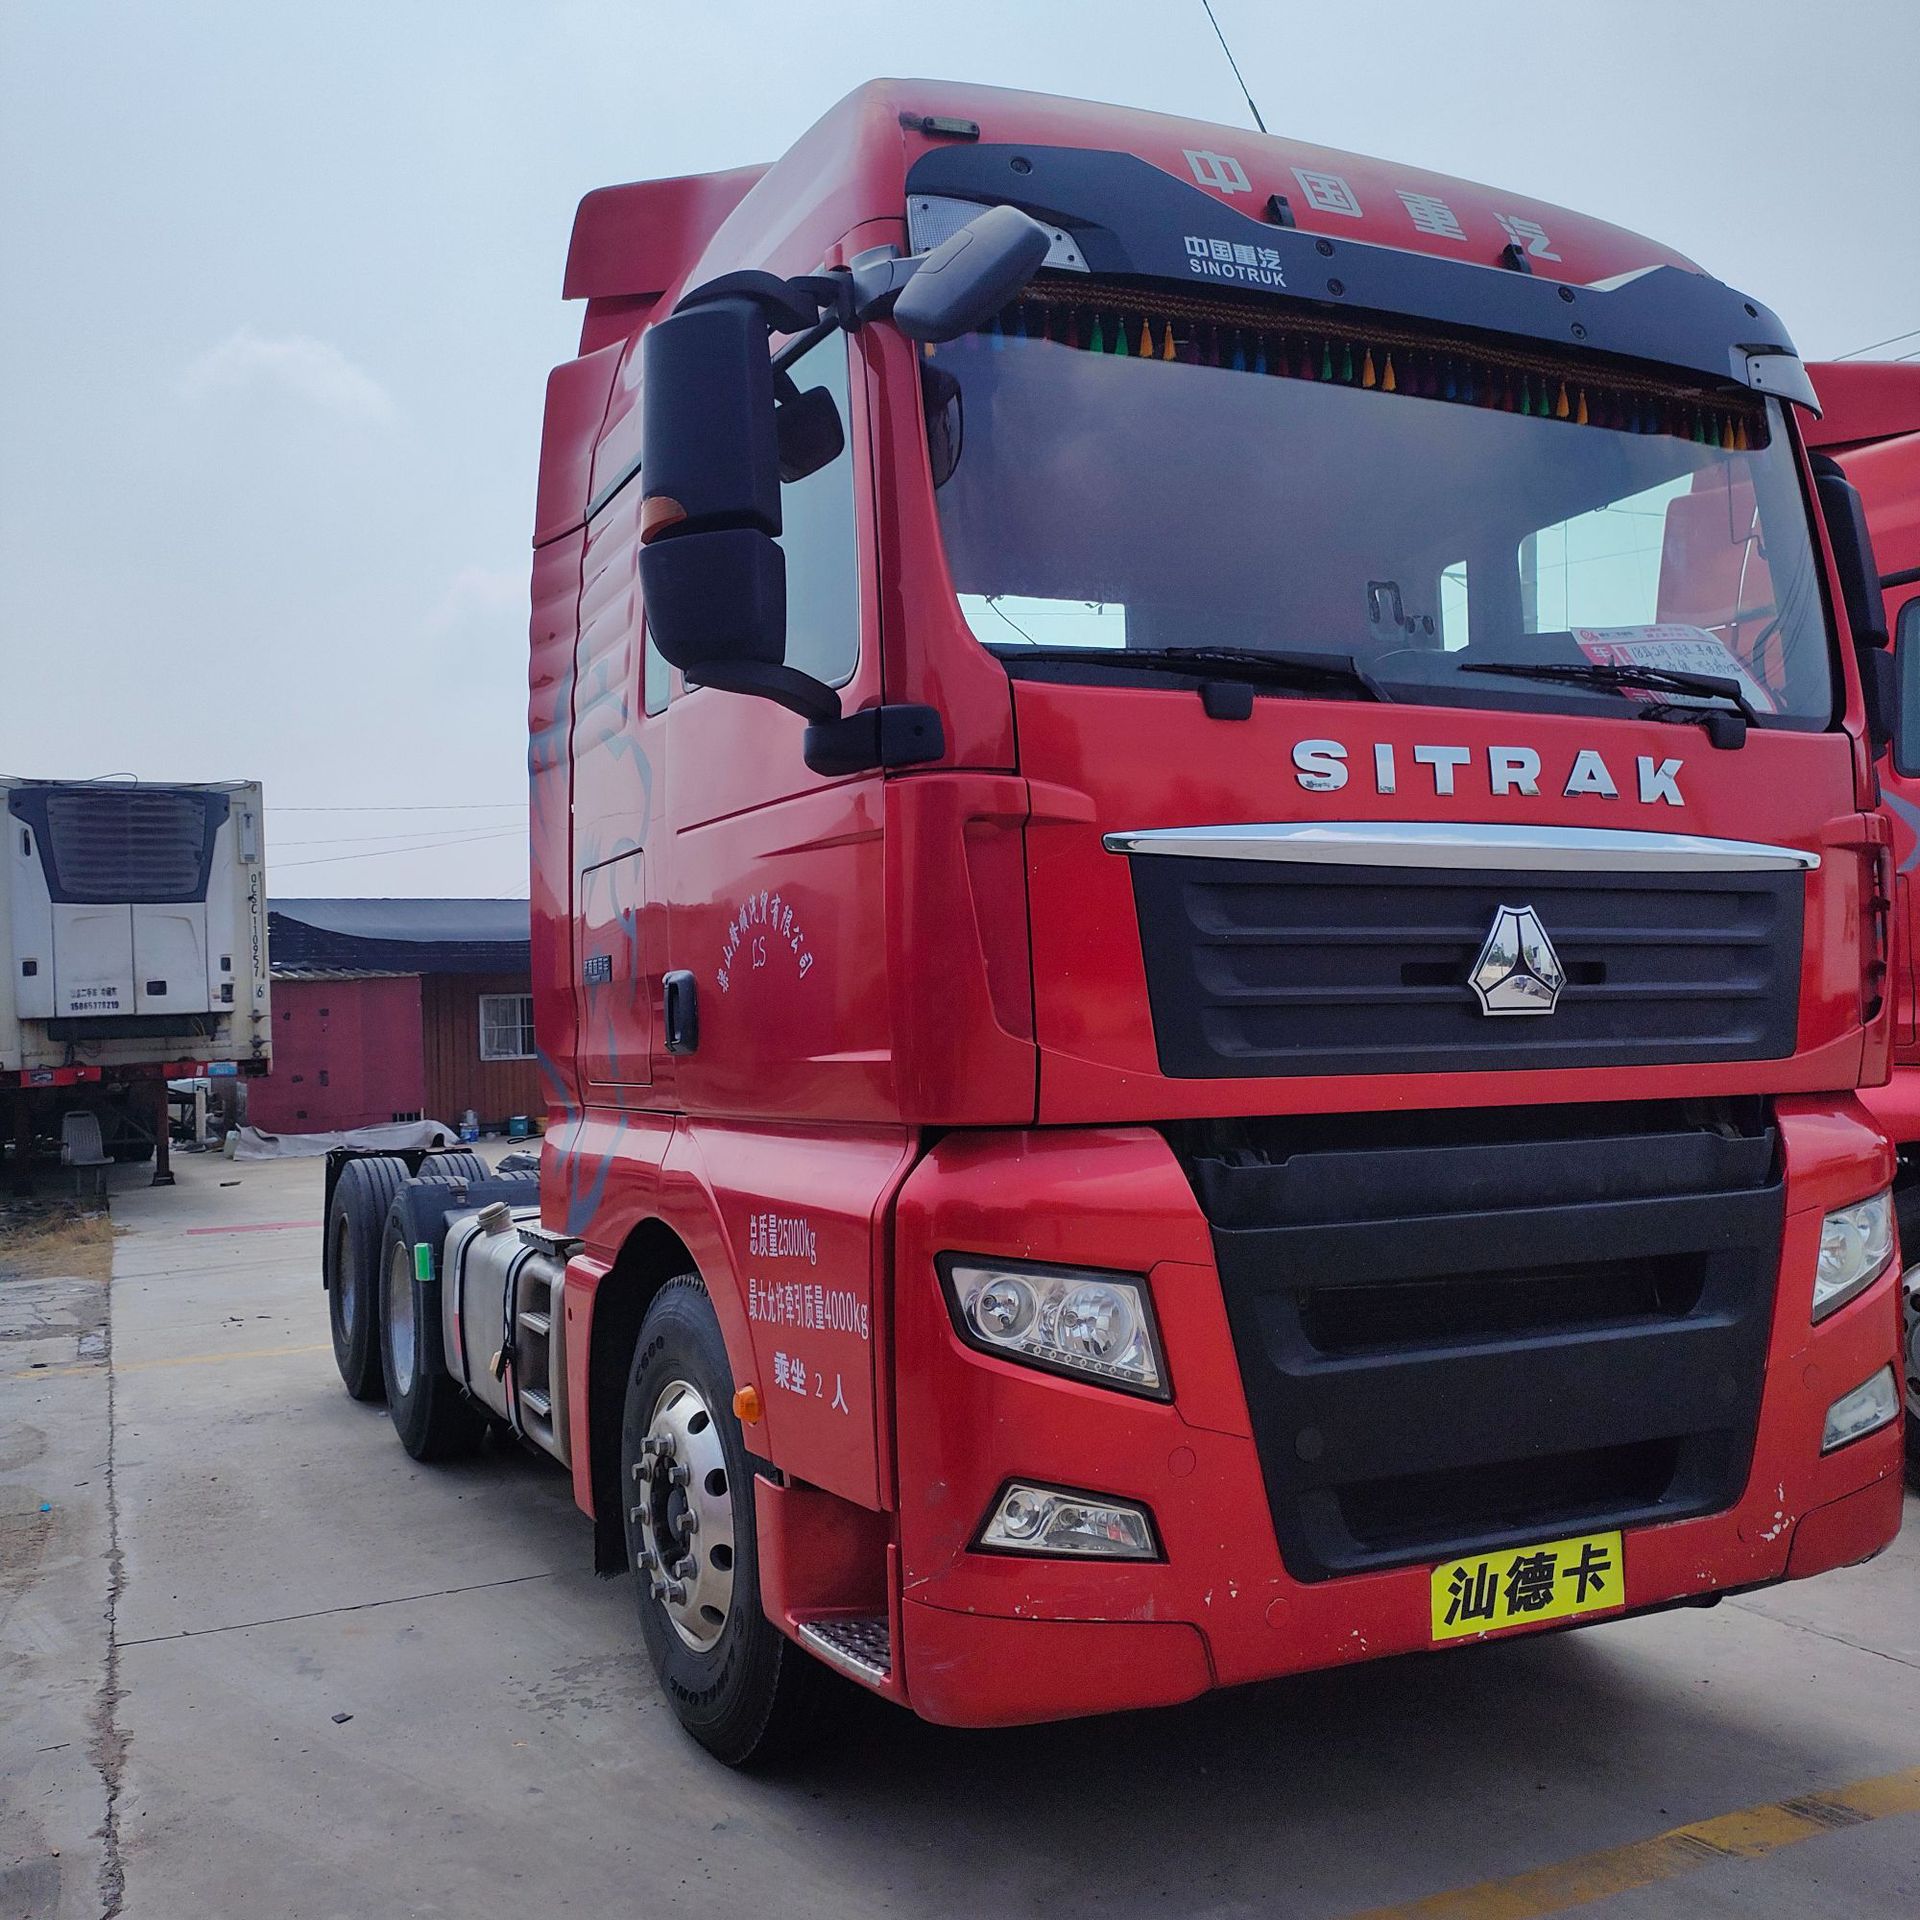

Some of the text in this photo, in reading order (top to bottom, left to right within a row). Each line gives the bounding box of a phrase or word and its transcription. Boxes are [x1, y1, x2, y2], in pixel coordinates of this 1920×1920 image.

[1182, 148, 1562, 263] 中国重汽
[1183, 235, 1282, 271] 中国重汽
[1189, 257, 1287, 288] SINOTRUK
[1292, 739, 1685, 807] SITRAK
[749, 1213, 817, 1266] 总质量25000kg
[748, 1278, 870, 1340] 最大允许牵引质量4000kg
[773, 1351, 850, 1416] 乘坐 2 人
[1443, 1543, 1612, 1626] 汕德卡
